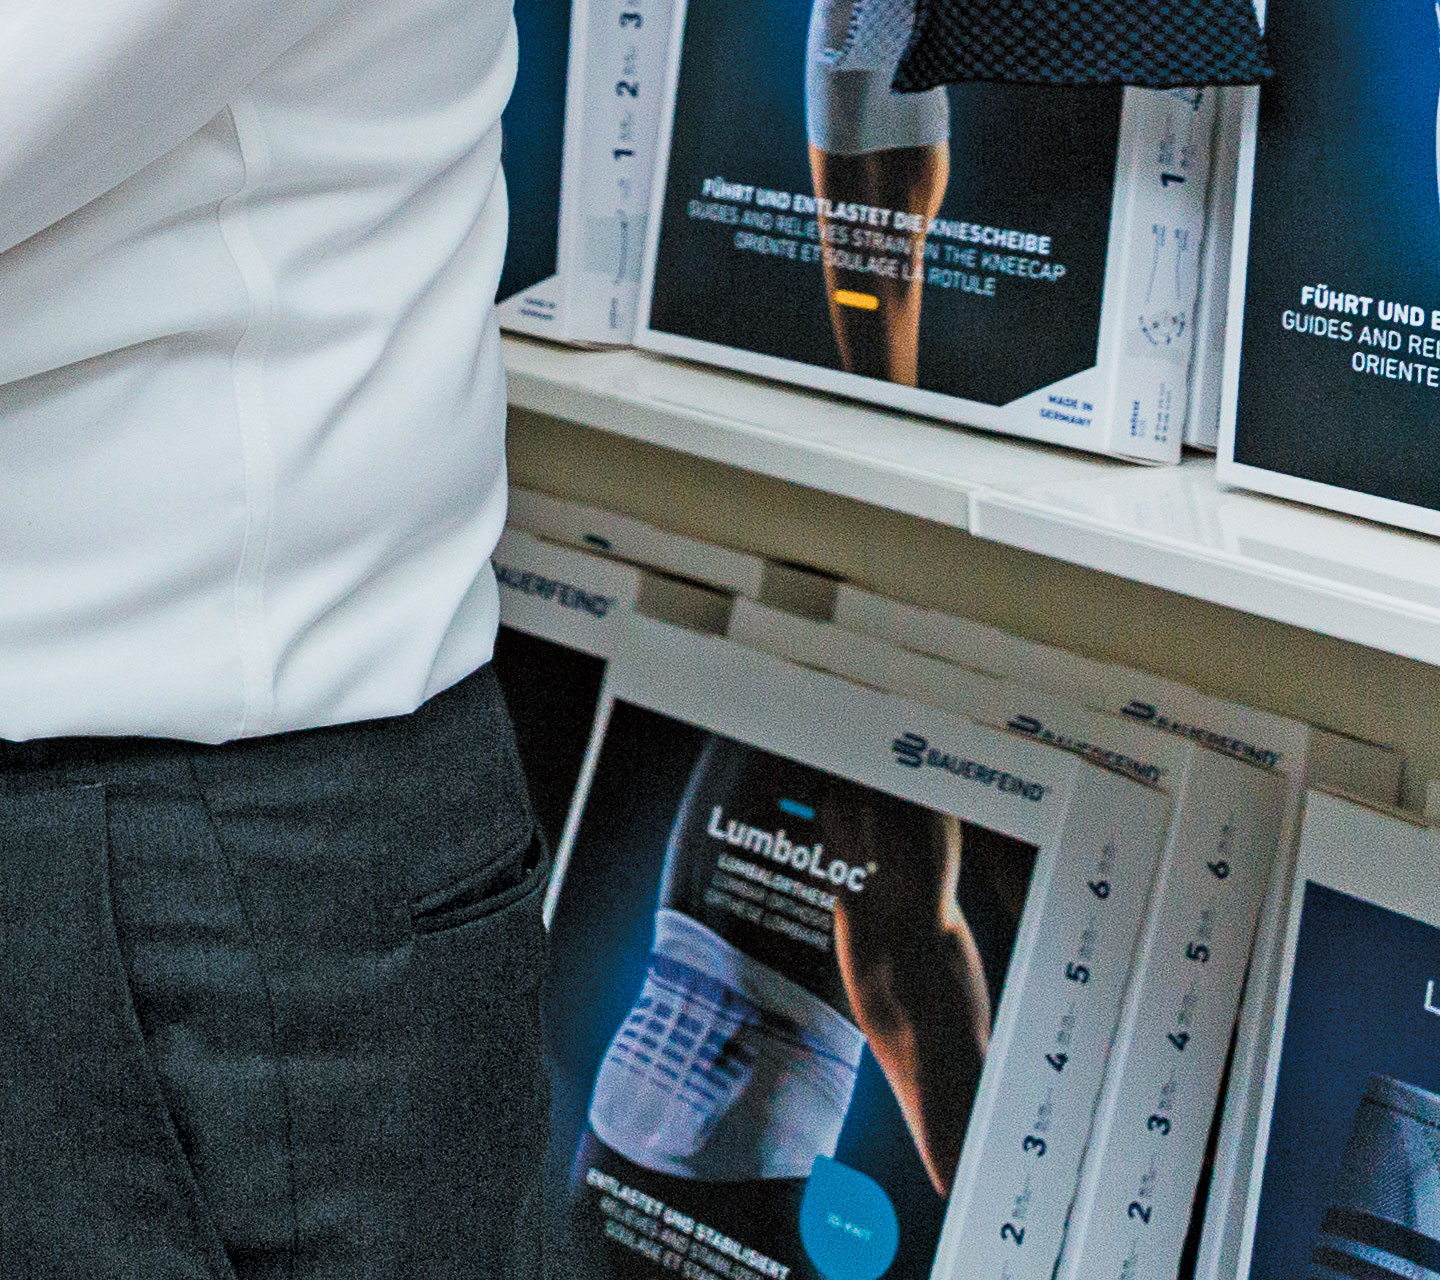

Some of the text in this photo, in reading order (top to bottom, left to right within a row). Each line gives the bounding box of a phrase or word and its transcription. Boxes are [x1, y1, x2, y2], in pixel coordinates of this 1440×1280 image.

[1301, 283, 1374, 317] FÜHRT
[1378, 300, 1425, 326] UND
[1282, 310, 1353, 342] GUIDES
[1358, 325, 1402, 351] AND
[1207, 859, 1231, 881] 6
[1087, 879, 1111, 900] 6
[1185, 941, 1210, 964] 5
[1066, 961, 1091, 985] 5
[1168, 1031, 1192, 1052] 4
[1044, 1051, 1068, 1073] 4
[1146, 1114, 1172, 1137] 3
[1021, 1135, 1048, 1158] 3
[1127, 1201, 1154, 1225] 2
[1000, 1223, 1026, 1247] 2
